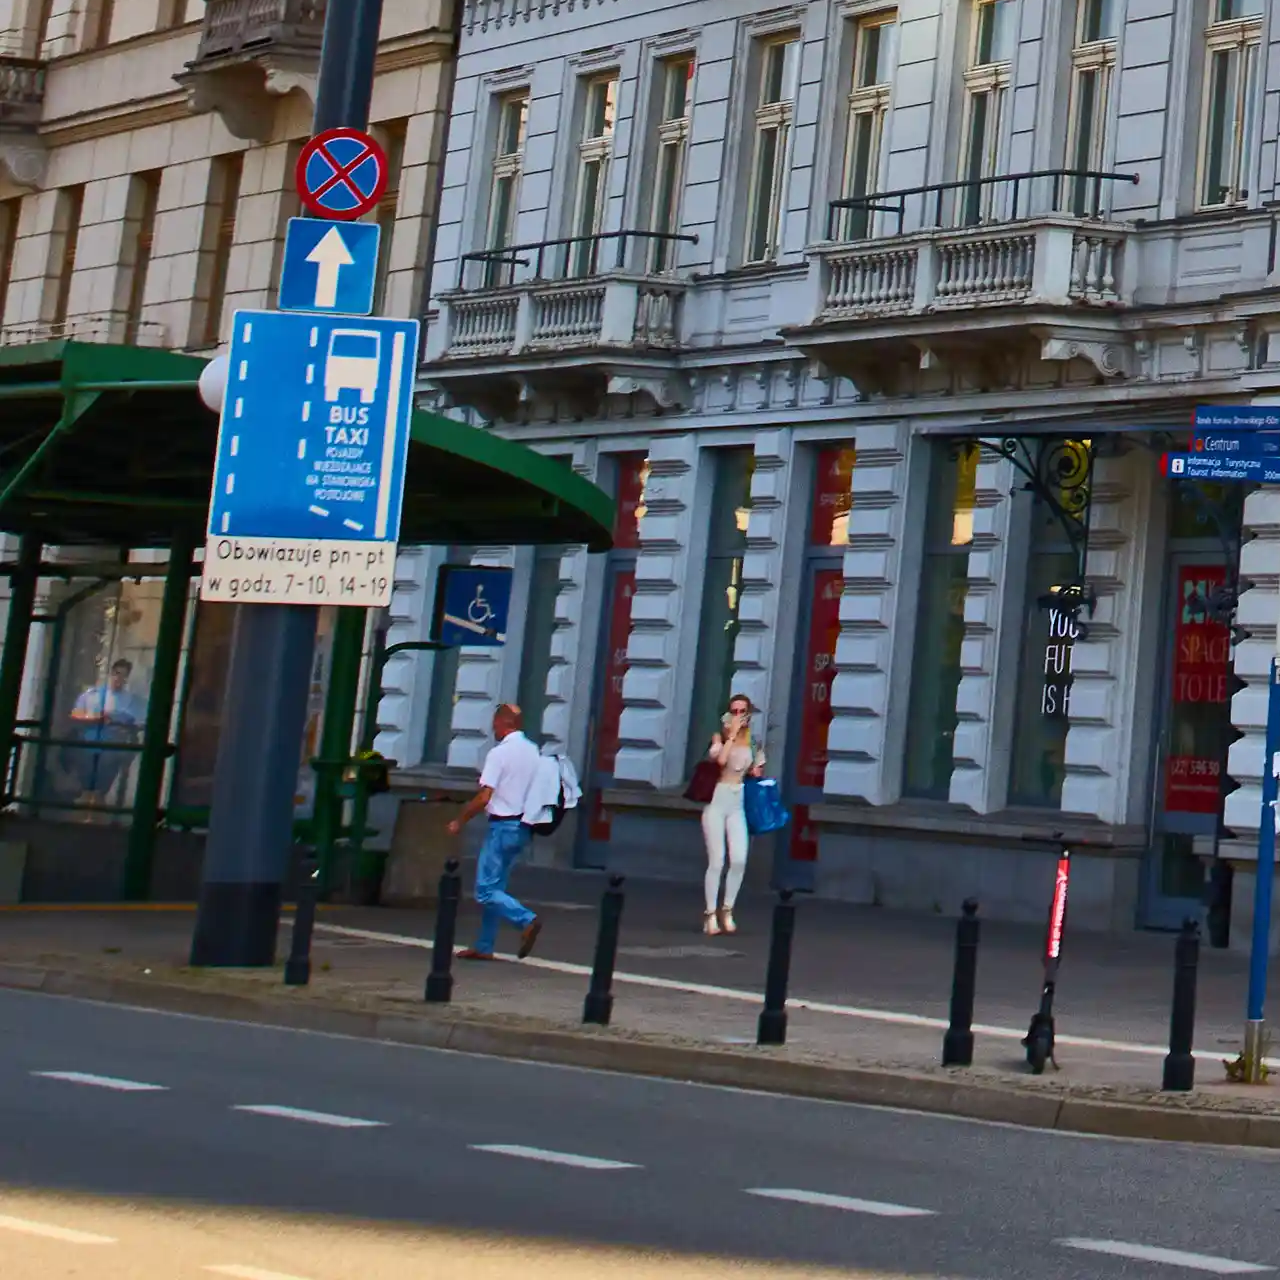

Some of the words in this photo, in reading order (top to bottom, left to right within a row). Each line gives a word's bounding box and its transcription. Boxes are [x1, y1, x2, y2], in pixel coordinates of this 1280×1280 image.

[329, 406, 369, 425] BUS
[325, 427, 369, 445] TAXI
[1205, 436, 1240, 451] Centrum
[1187, 467, 1208, 477] Tourist
[1264, 471, 1280, 480] 300m
[209, 577, 222, 591] w
[229, 574, 276, 597] godz.
[1041, 684, 1056, 714] IS
